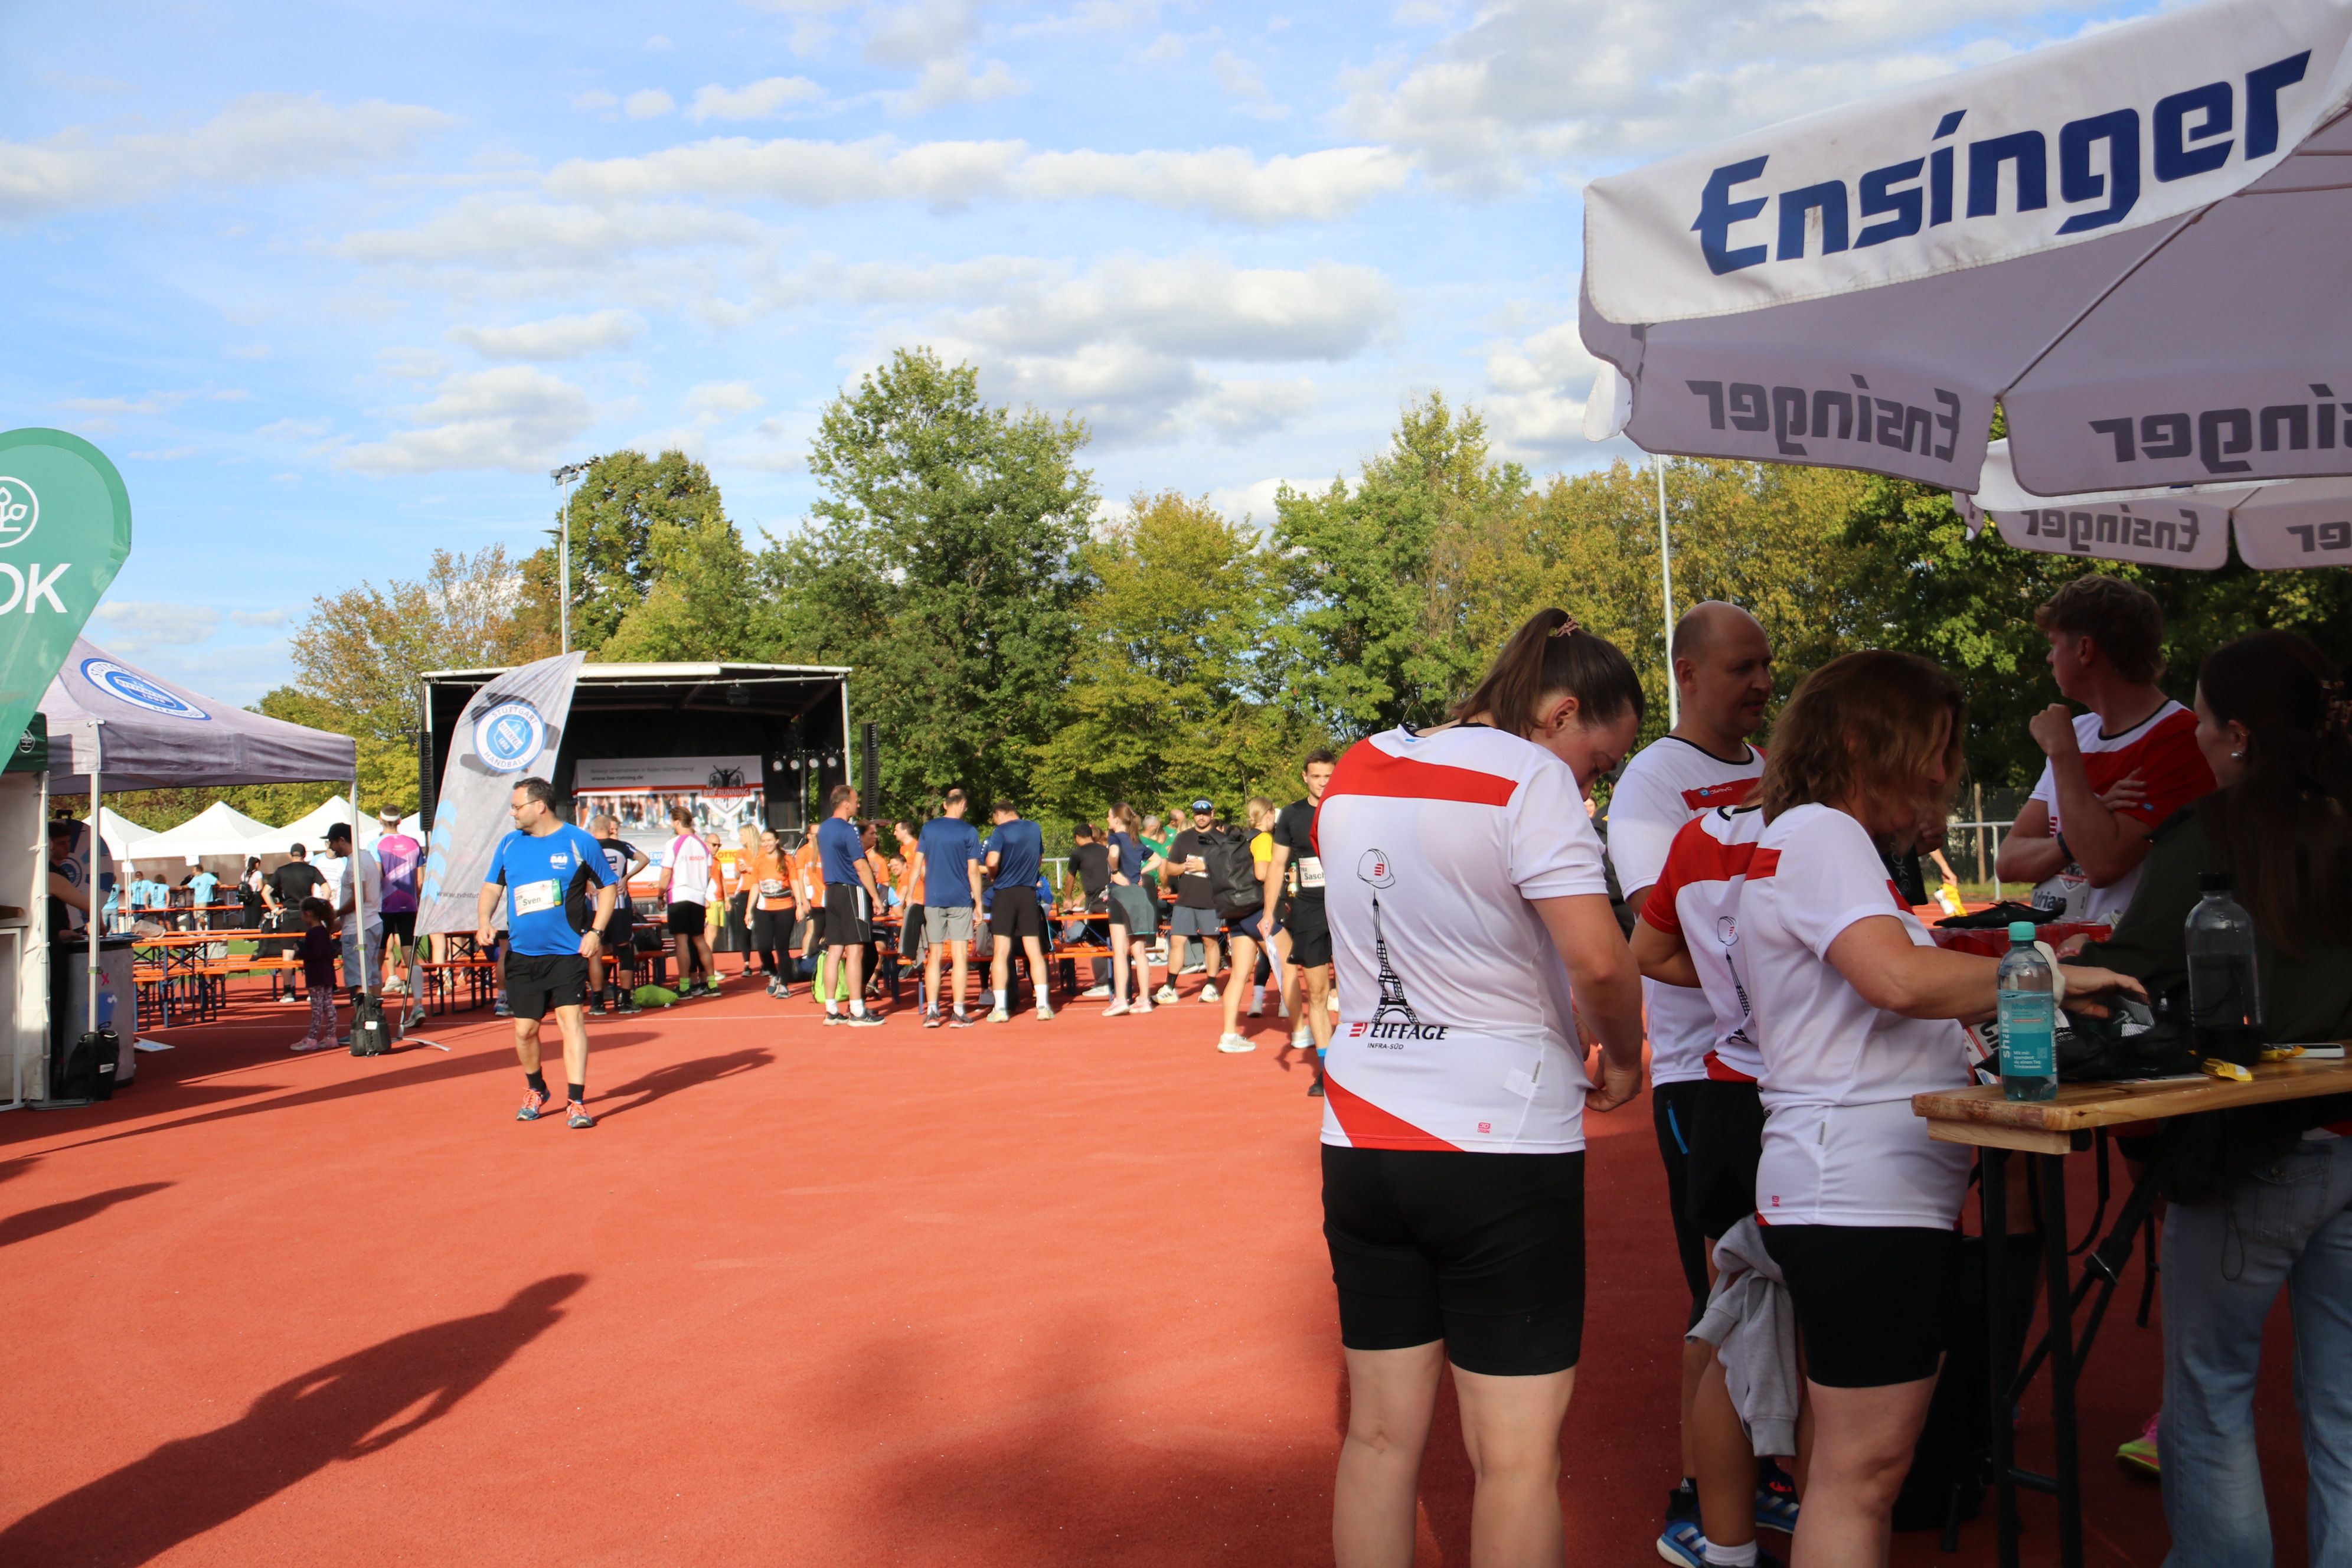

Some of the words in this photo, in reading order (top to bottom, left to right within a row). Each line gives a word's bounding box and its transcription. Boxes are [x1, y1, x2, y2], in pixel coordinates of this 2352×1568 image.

[1691, 49, 2311, 275] Ensinger
[491, 706, 538, 724] STUTTGART
[484, 750, 528, 767] HANDBALL
[703, 788, 749, 796] BW-RUNNING
[522, 897, 541, 906] Sven
[1370, 1022, 1449, 1041] EIFFAGE
[2001, 1010, 2010, 1058] share
[1367, 1042, 1404, 1050] INFRA-SÜD
